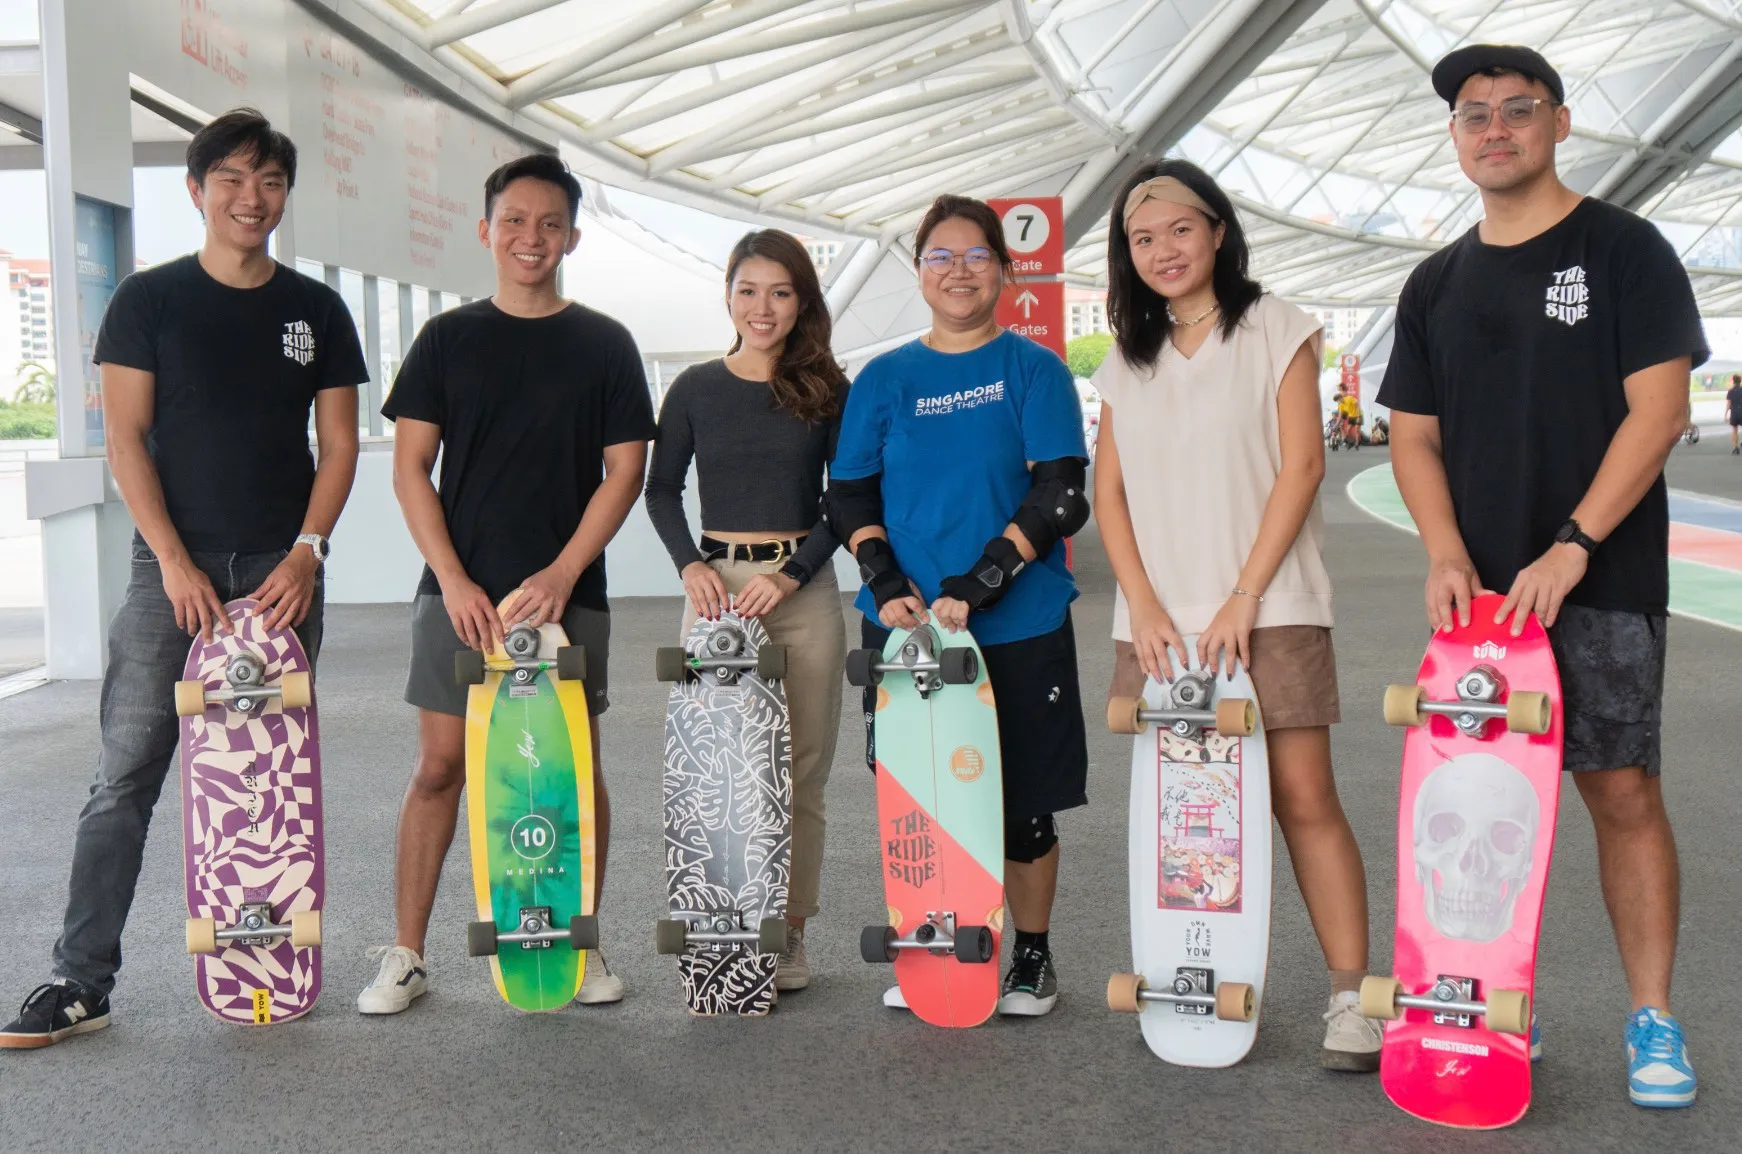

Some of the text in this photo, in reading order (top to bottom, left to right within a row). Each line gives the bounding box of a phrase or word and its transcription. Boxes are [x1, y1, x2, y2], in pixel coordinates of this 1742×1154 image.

[1017, 215, 1034, 241] 7
[1011, 259, 1043, 271] Gate
[1553, 265, 1587, 285] THE
[1546, 283, 1590, 305] RIDE
[1545, 303, 1589, 326] SIDE
[284, 320, 313, 335] THE
[1009, 323, 1048, 336] Gates
[282, 333, 316, 350] RIDE
[283, 345, 315, 366] SIDE
[915, 391, 1004, 417] DANCE THEATRE
[916, 380, 1004, 408] SINGAPORE
[890, 808, 931, 835] THE
[519, 827, 546, 847] 10
[887, 834, 936, 862] RIDE
[506, 866, 565, 876] MEDINA
[889, 861, 936, 889] SIDE
[1186, 947, 1211, 957] YOW
[1421, 1036, 1489, 1057] CHRISTENSON
